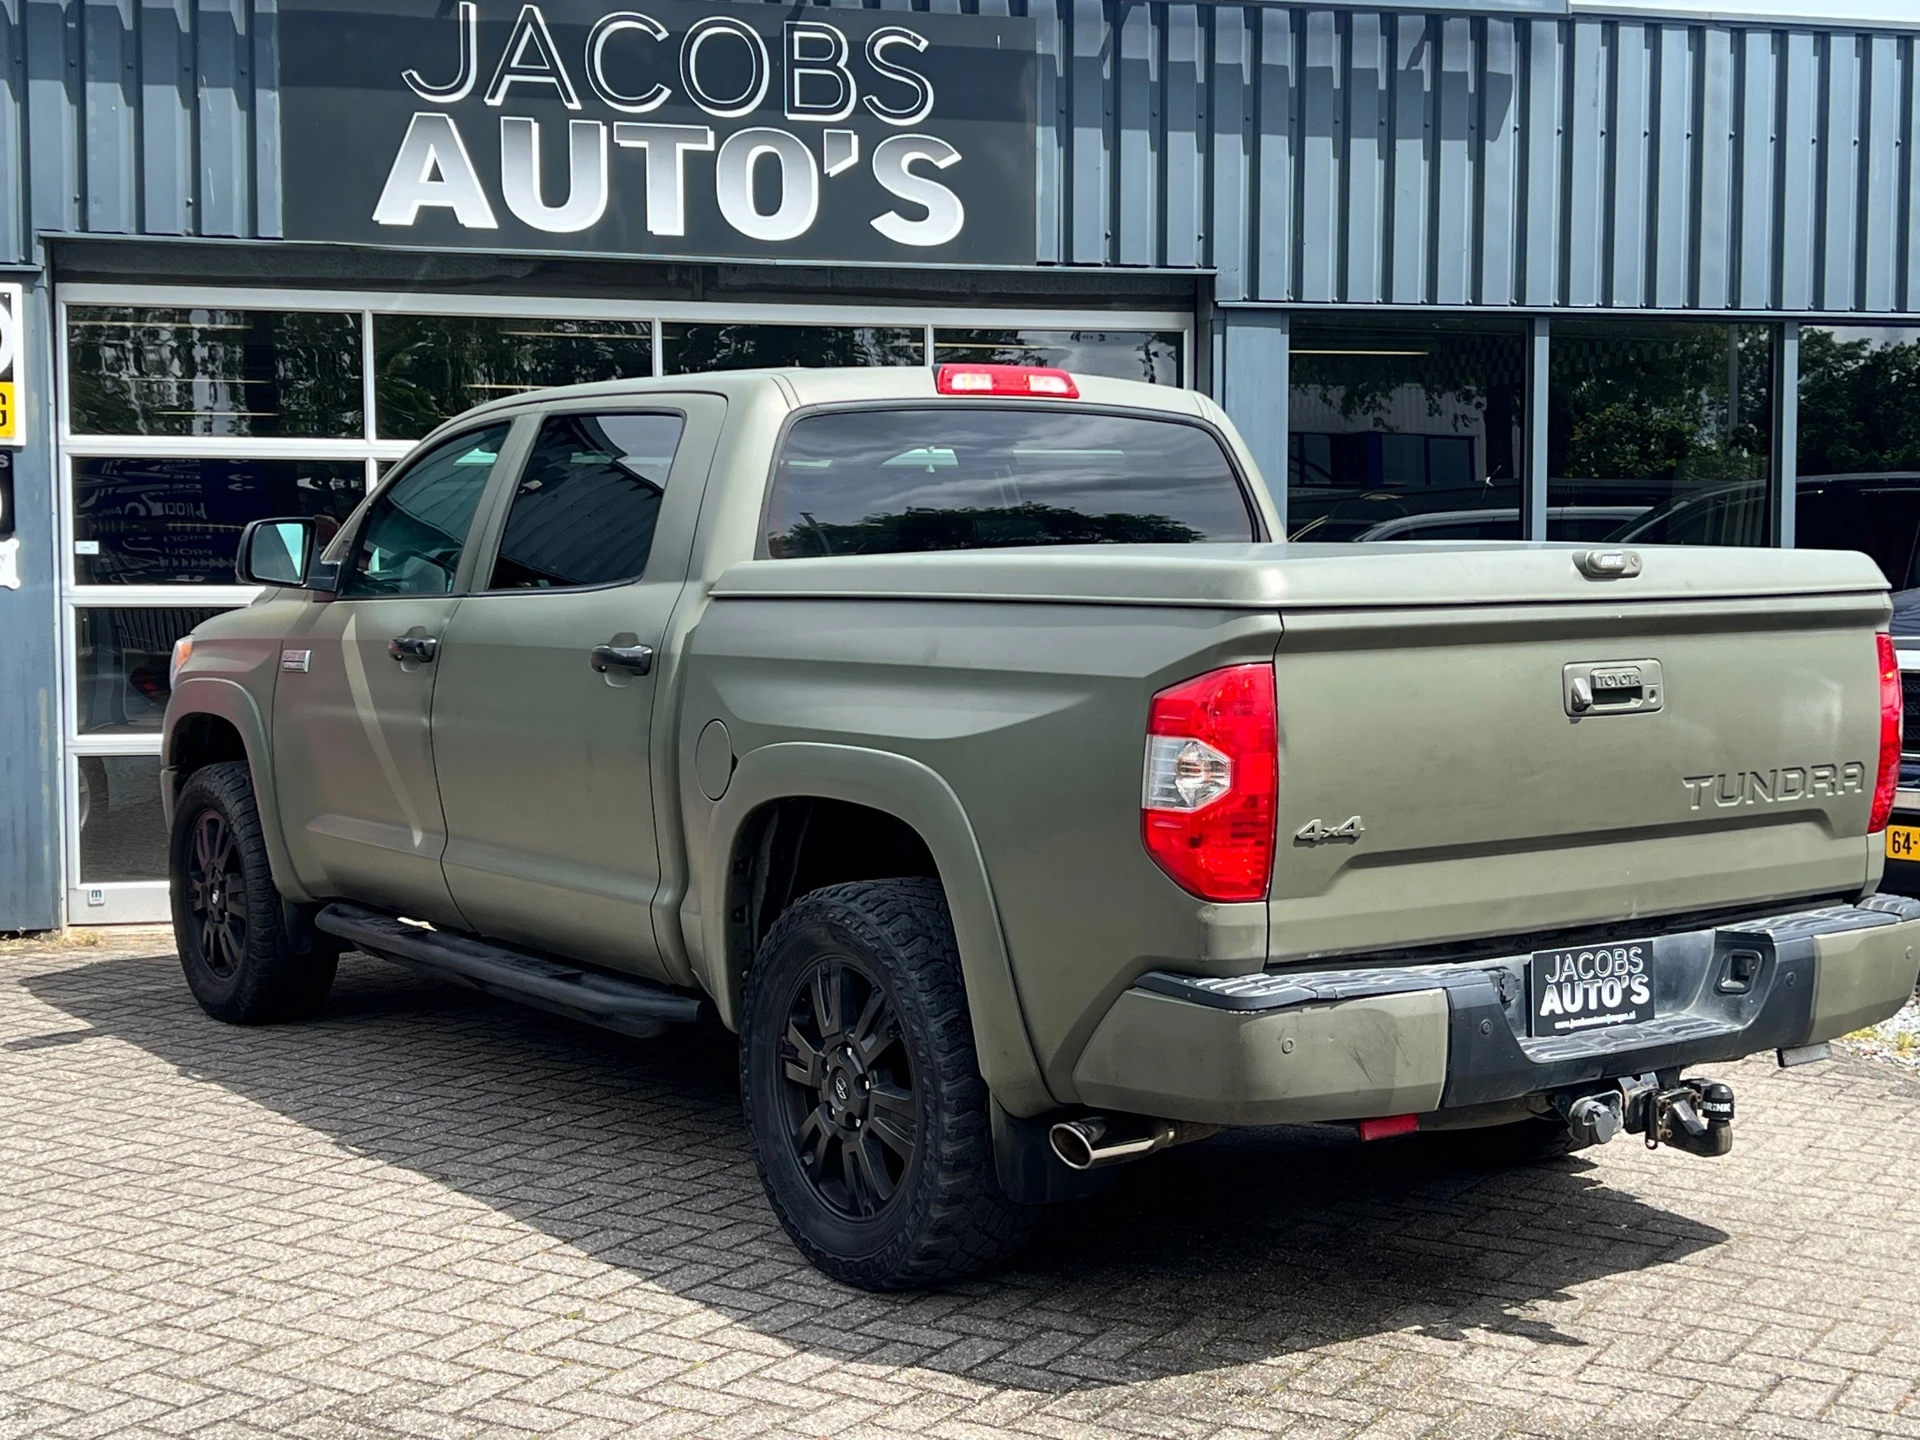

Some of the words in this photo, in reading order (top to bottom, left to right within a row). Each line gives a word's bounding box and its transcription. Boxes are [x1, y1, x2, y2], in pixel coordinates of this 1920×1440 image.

[401, 1, 935, 126] JACOBS
[372, 111, 965, 247] AUTO'S
[1597, 672, 1642, 687] TOYOTA
[1683, 761, 1866, 811] TUNDRA
[1296, 815, 1366, 842] 4x4
[1891, 830, 1920, 855] 64-
[1544, 946, 1644, 983] JACOBS
[1539, 973, 1651, 1016] AUTO'S
